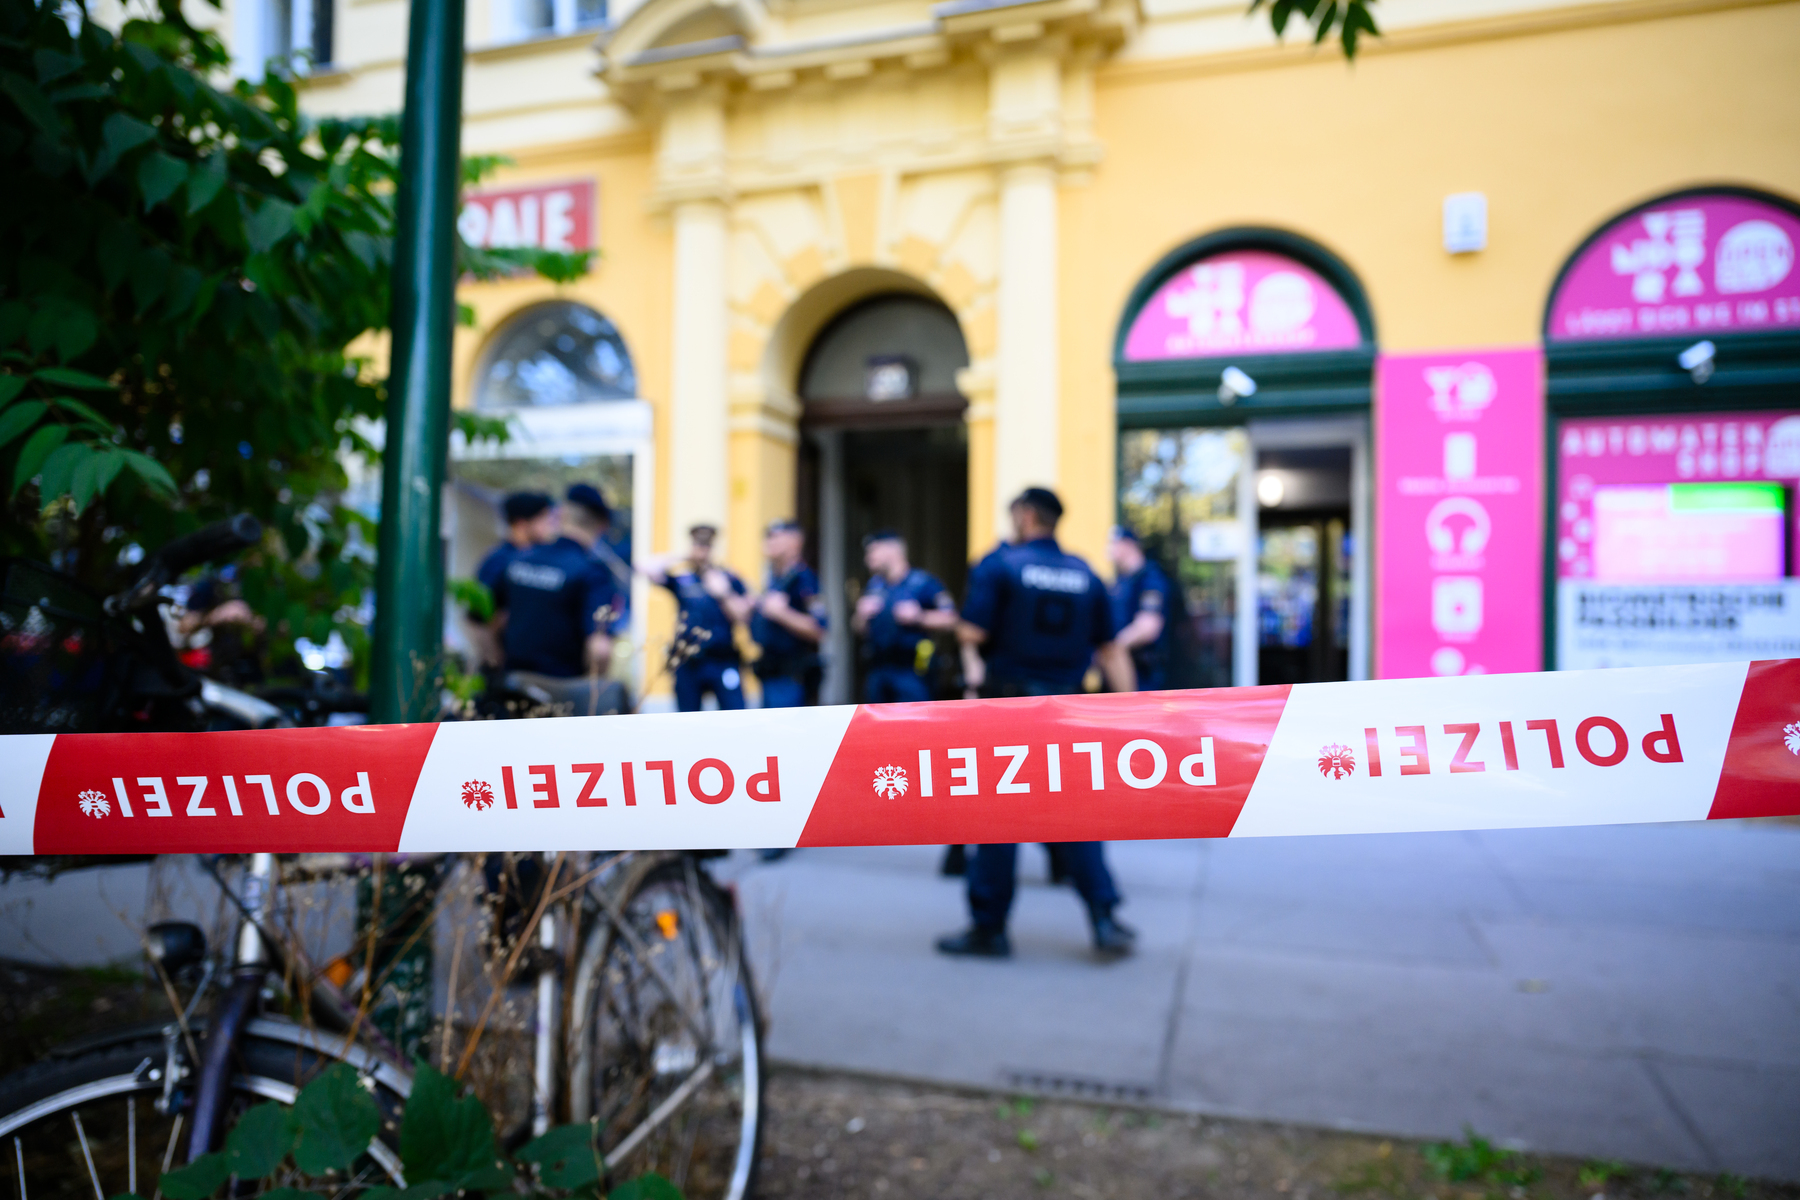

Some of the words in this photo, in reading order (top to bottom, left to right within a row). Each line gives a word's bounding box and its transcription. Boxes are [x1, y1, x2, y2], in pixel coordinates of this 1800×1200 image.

[1563, 423, 1763, 456] AUTOMATEN
[1677, 449, 1761, 477] SHOP
[1022, 565, 1089, 594] POLIZEI
[918, 736, 1217, 797] POLIZEI
[1364, 713, 1684, 777] POLIZEI
[112, 772, 376, 818] POLIZEI
[501, 756, 781, 810] POLIZEI
